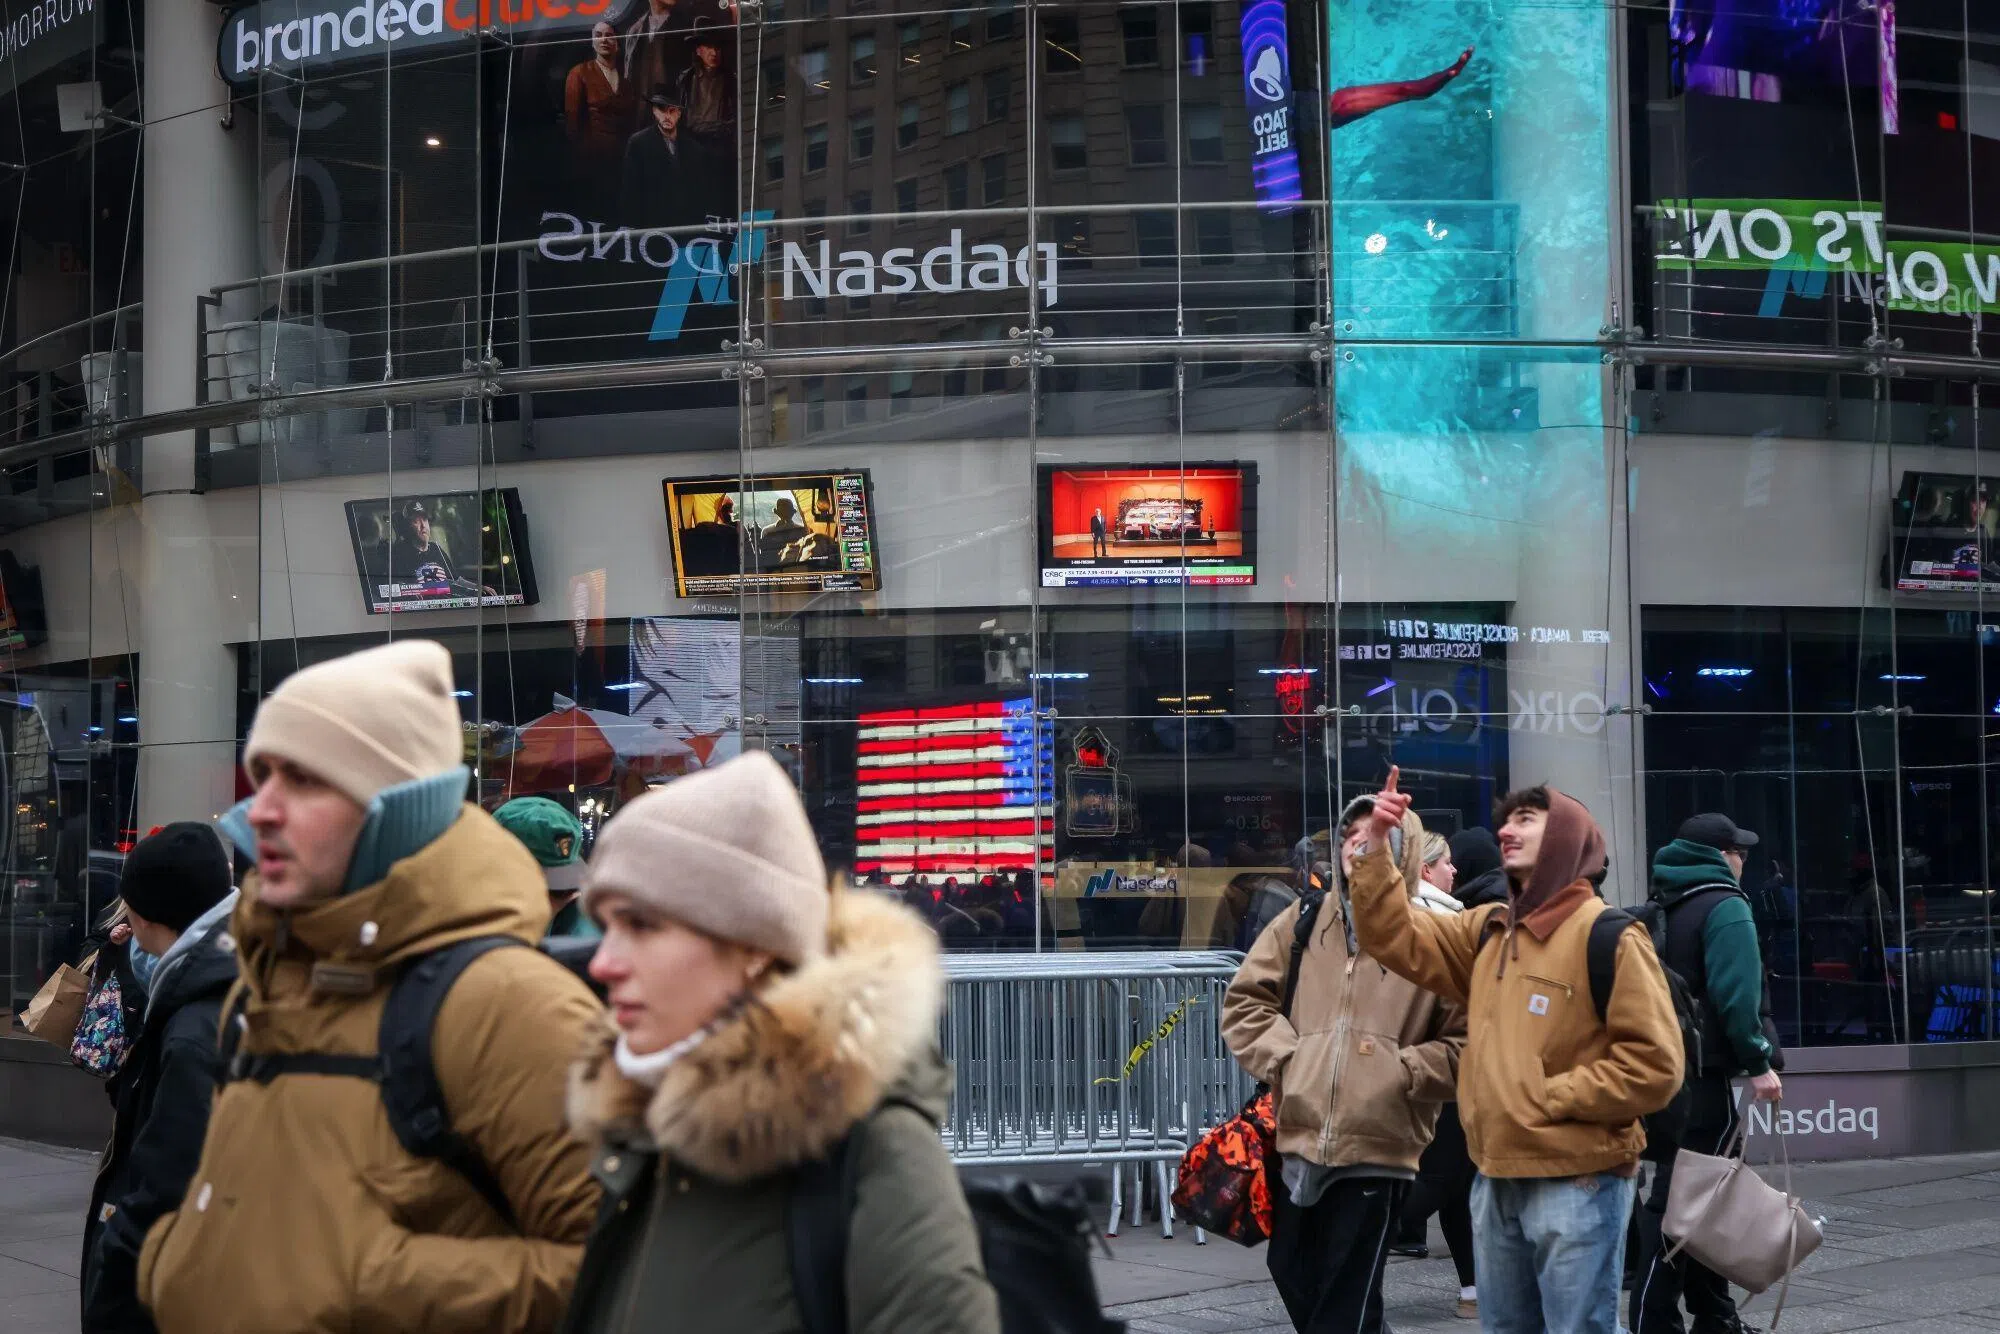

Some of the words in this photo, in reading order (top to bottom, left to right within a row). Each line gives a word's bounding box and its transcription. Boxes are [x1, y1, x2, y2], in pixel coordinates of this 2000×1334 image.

[783, 229, 1058, 307] Nasdaq
[1915, 782, 1952, 791] EPSICO
[1115, 875, 1177, 894] Nasdaq
[1748, 1099, 1879, 1140] Nasdaq
